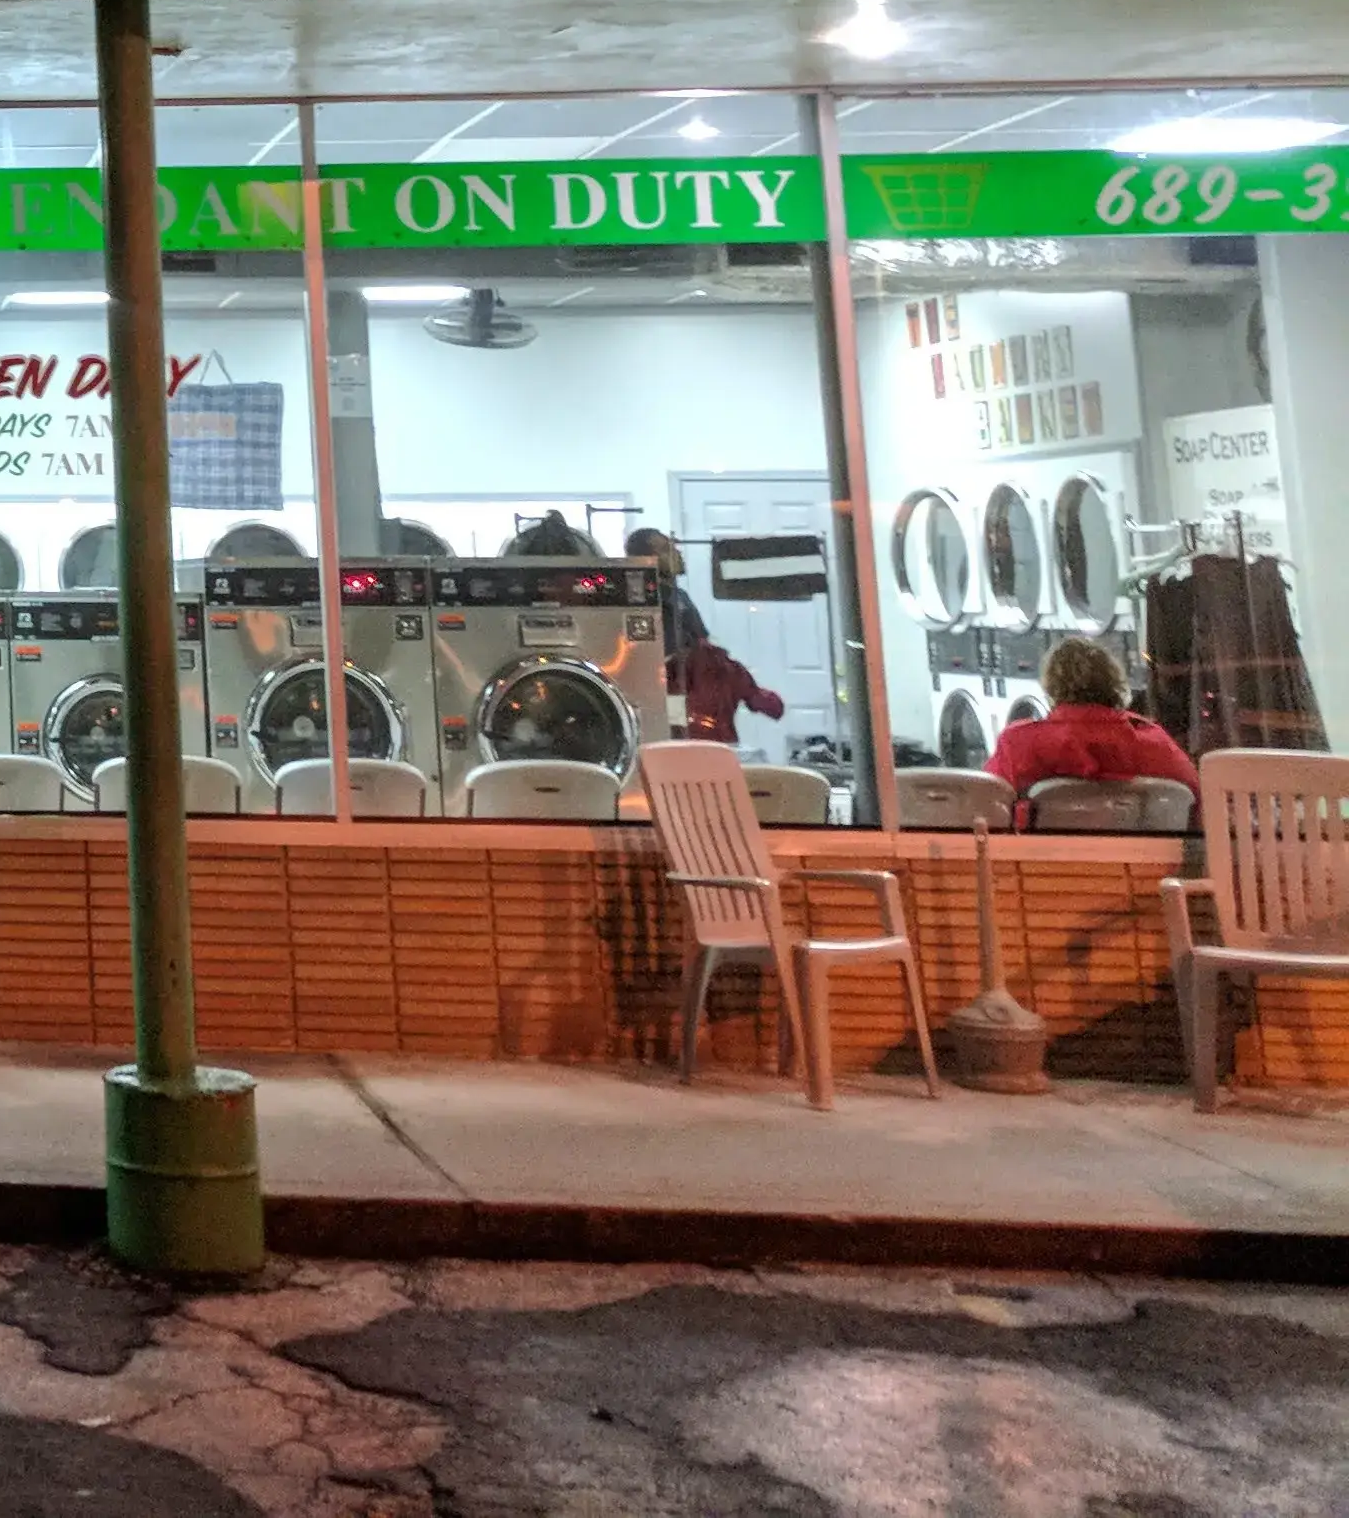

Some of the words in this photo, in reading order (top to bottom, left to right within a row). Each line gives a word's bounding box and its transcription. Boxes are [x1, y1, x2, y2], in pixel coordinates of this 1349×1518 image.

[394, 173, 518, 233] ON
[547, 169, 796, 232] DUTY
[1094, 163, 1349, 226] 689-3
[1173, 436, 1208, 464] SOAP
[1209, 431, 1271, 460] CENTER
[41, 452, 106, 477] 7AM
[1208, 488, 1244, 507] SOAP
